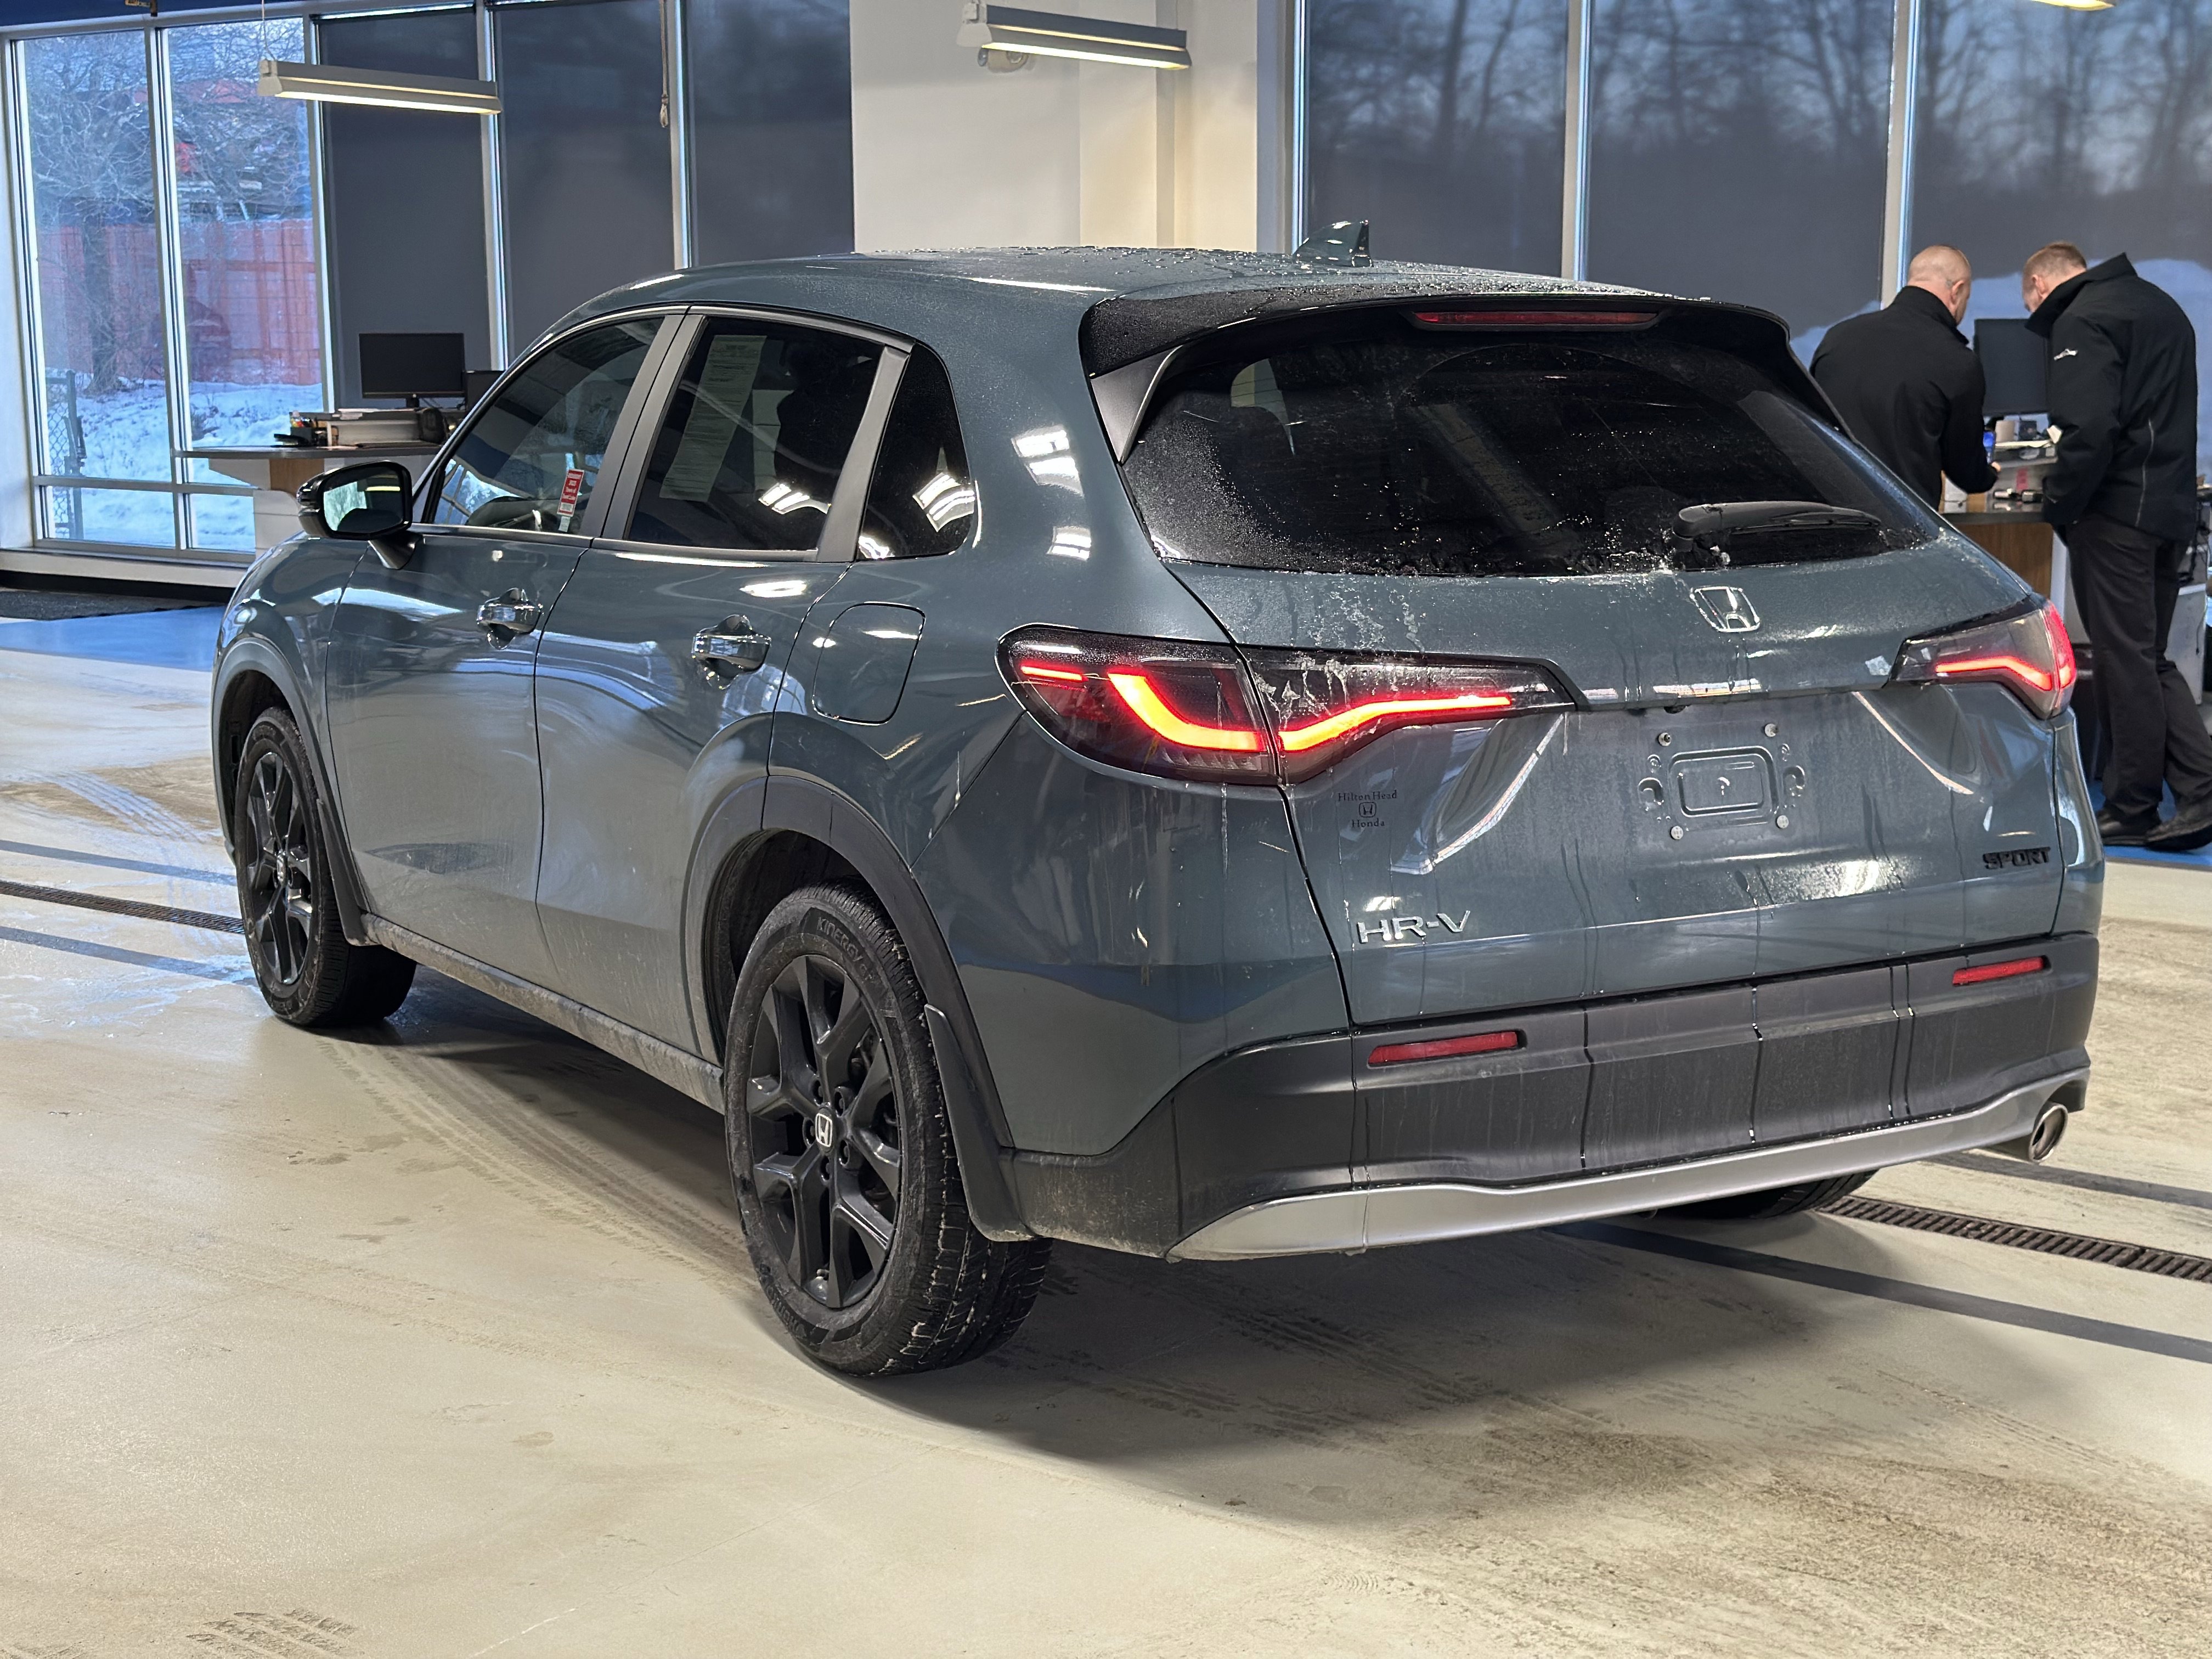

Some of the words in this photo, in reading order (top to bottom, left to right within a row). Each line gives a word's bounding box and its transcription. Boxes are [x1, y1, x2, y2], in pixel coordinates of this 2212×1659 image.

[1338, 792, 1371, 802] Hilton
[1373, 789, 1397, 800] Head
[1351, 817, 1385, 828] Honda
[1982, 847, 2051, 870] SPORT
[1356, 910, 1471, 944] HR-V
